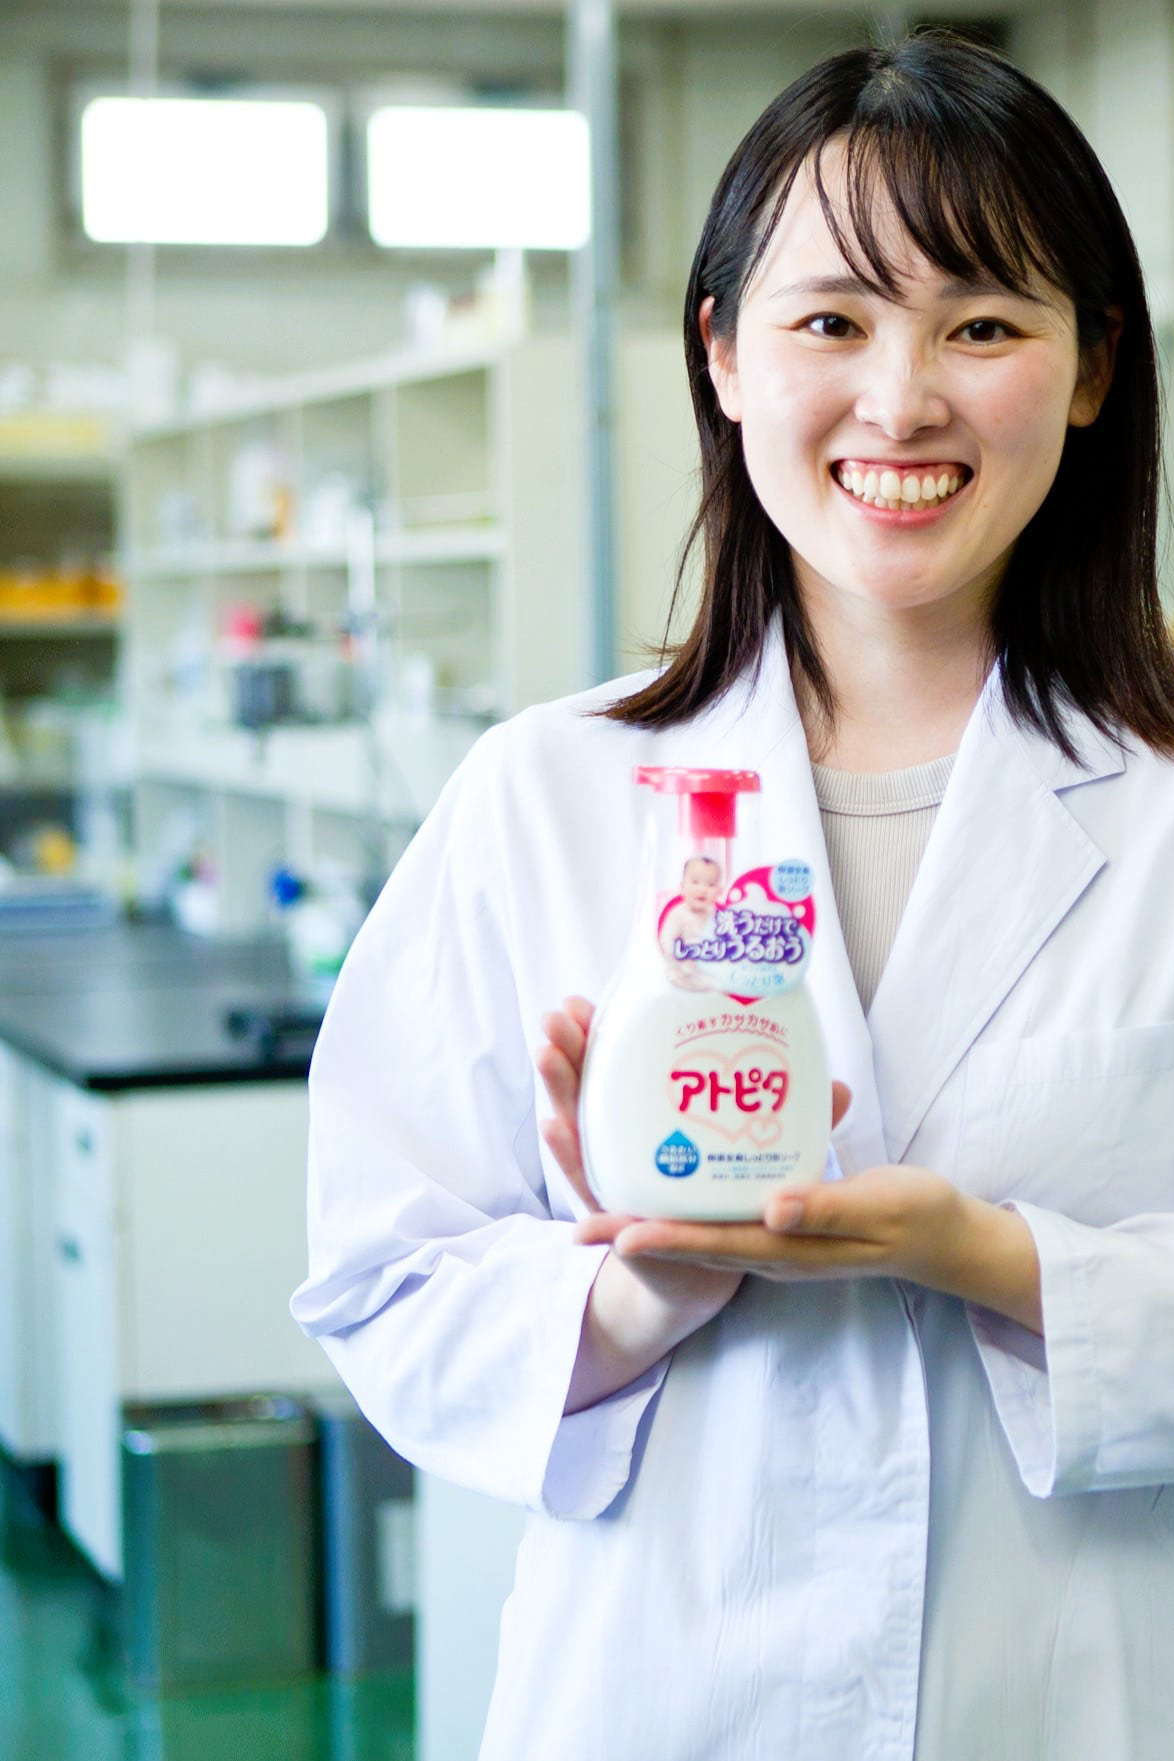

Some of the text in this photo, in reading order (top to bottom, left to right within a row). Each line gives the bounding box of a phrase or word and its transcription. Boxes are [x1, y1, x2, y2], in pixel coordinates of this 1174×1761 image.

[715, 909, 800, 936] 洗うだけで
[674, 936, 804, 964] しっとりうるおう
[671, 1068, 790, 1112] アトピタ
